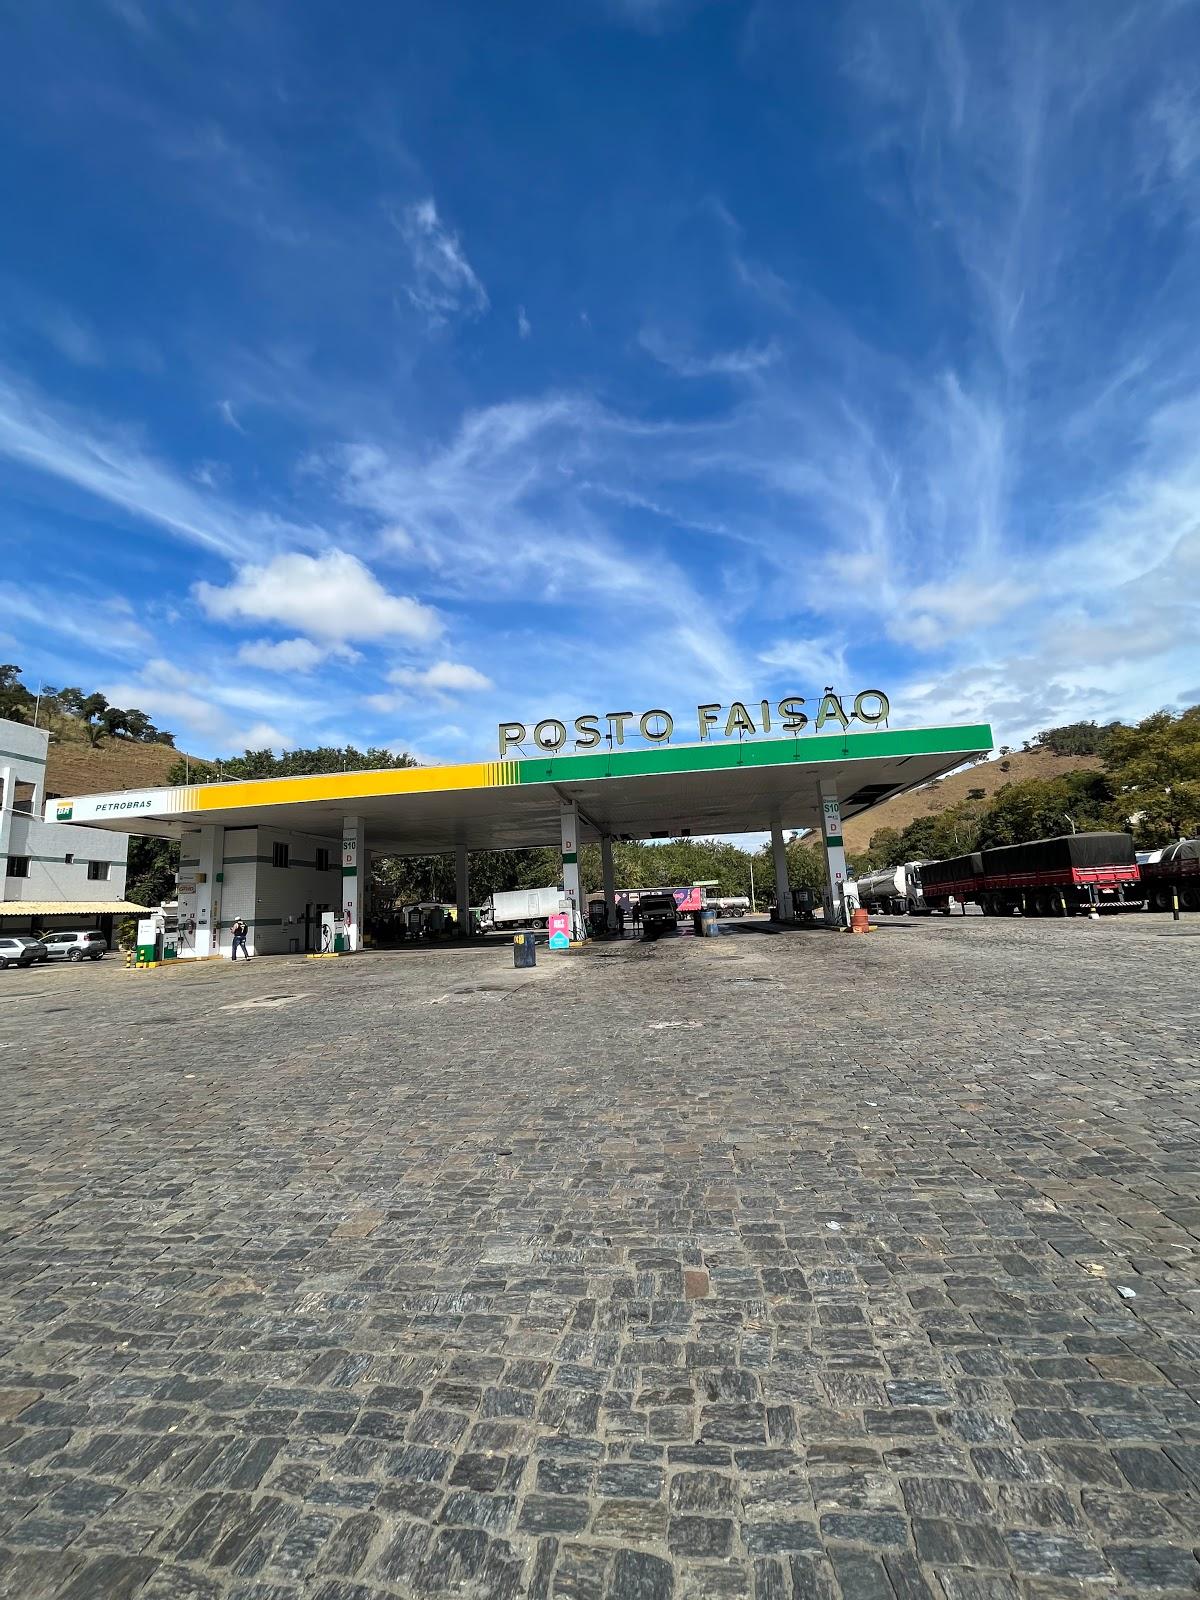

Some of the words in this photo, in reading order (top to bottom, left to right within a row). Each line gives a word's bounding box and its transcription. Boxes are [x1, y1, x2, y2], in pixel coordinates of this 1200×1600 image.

[498, 708, 674, 756] POSTO
[95, 800, 152, 812] PETROBRAS
[824, 803, 839, 813] S10
[830, 823, 837, 831] D
[343, 841, 356, 850] S10
[565, 841, 572, 849] D
